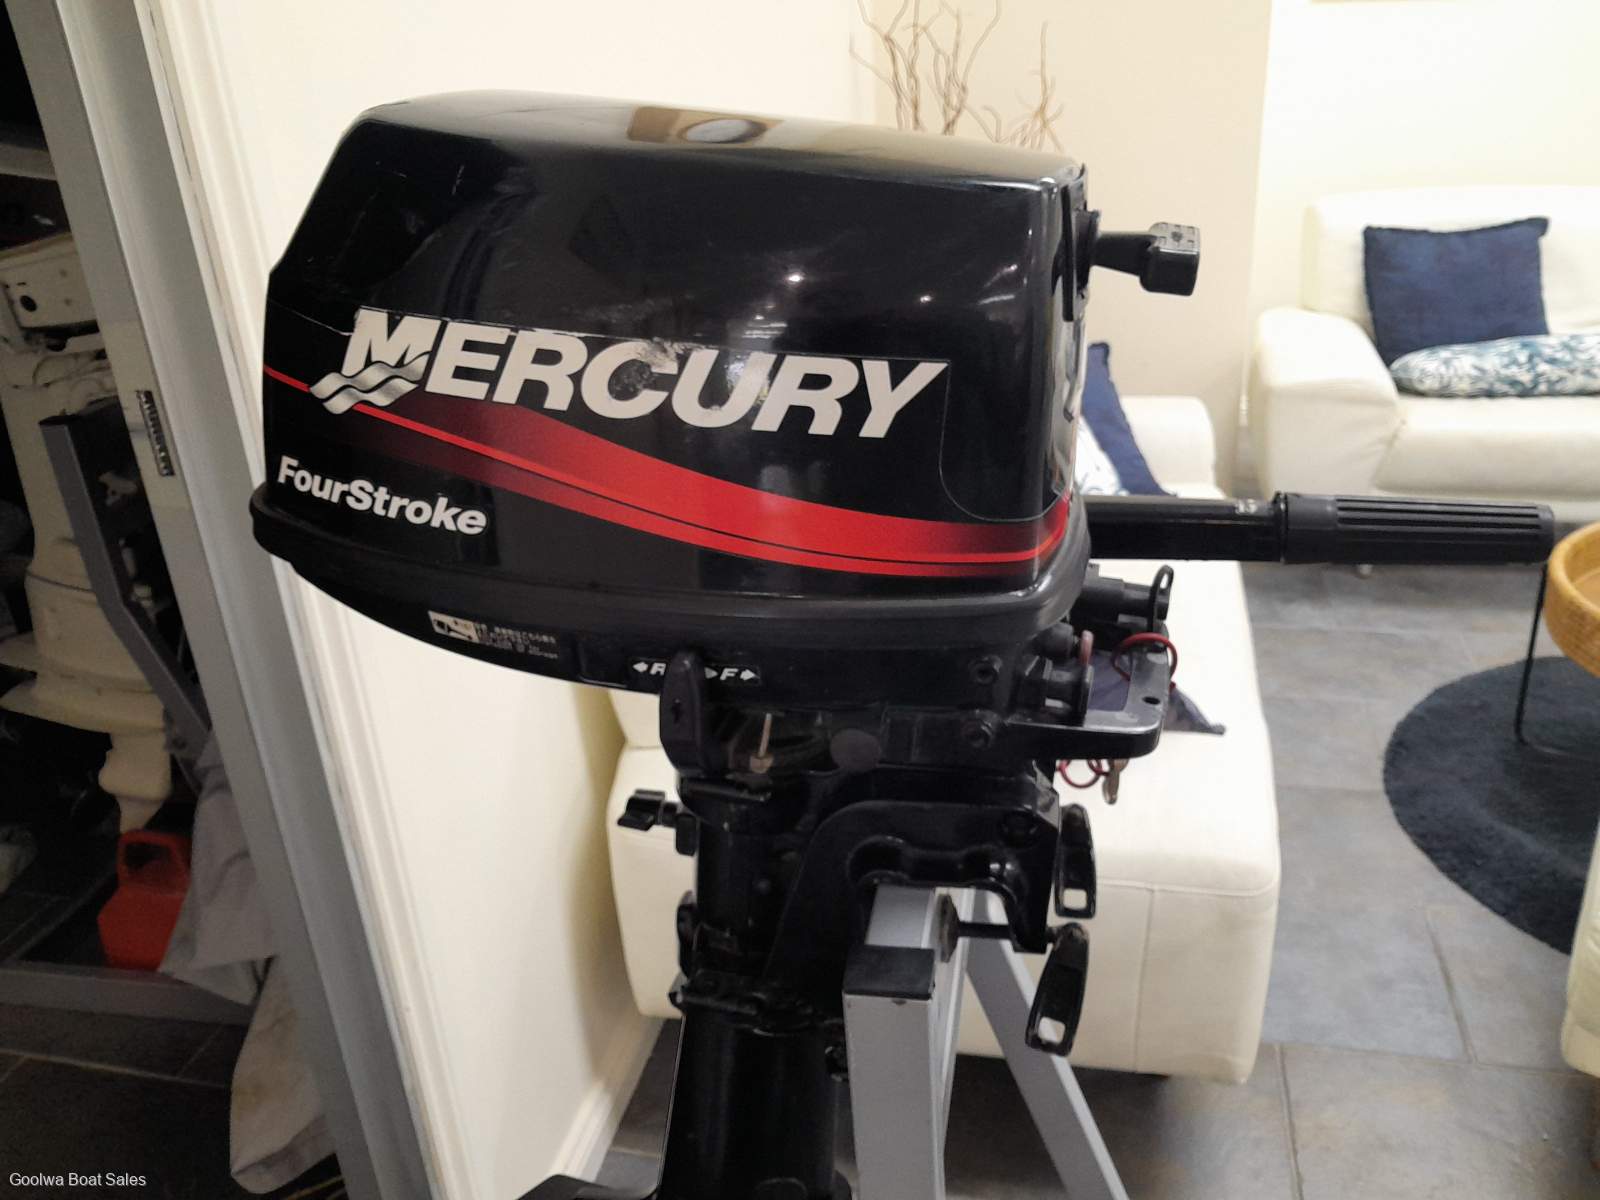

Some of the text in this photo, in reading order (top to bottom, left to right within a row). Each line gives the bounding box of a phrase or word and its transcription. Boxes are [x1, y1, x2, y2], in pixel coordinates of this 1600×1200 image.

[342, 308, 950, 438] MERCURY
[277, 454, 488, 536] FourStroke
[719, 667, 739, 681] F
